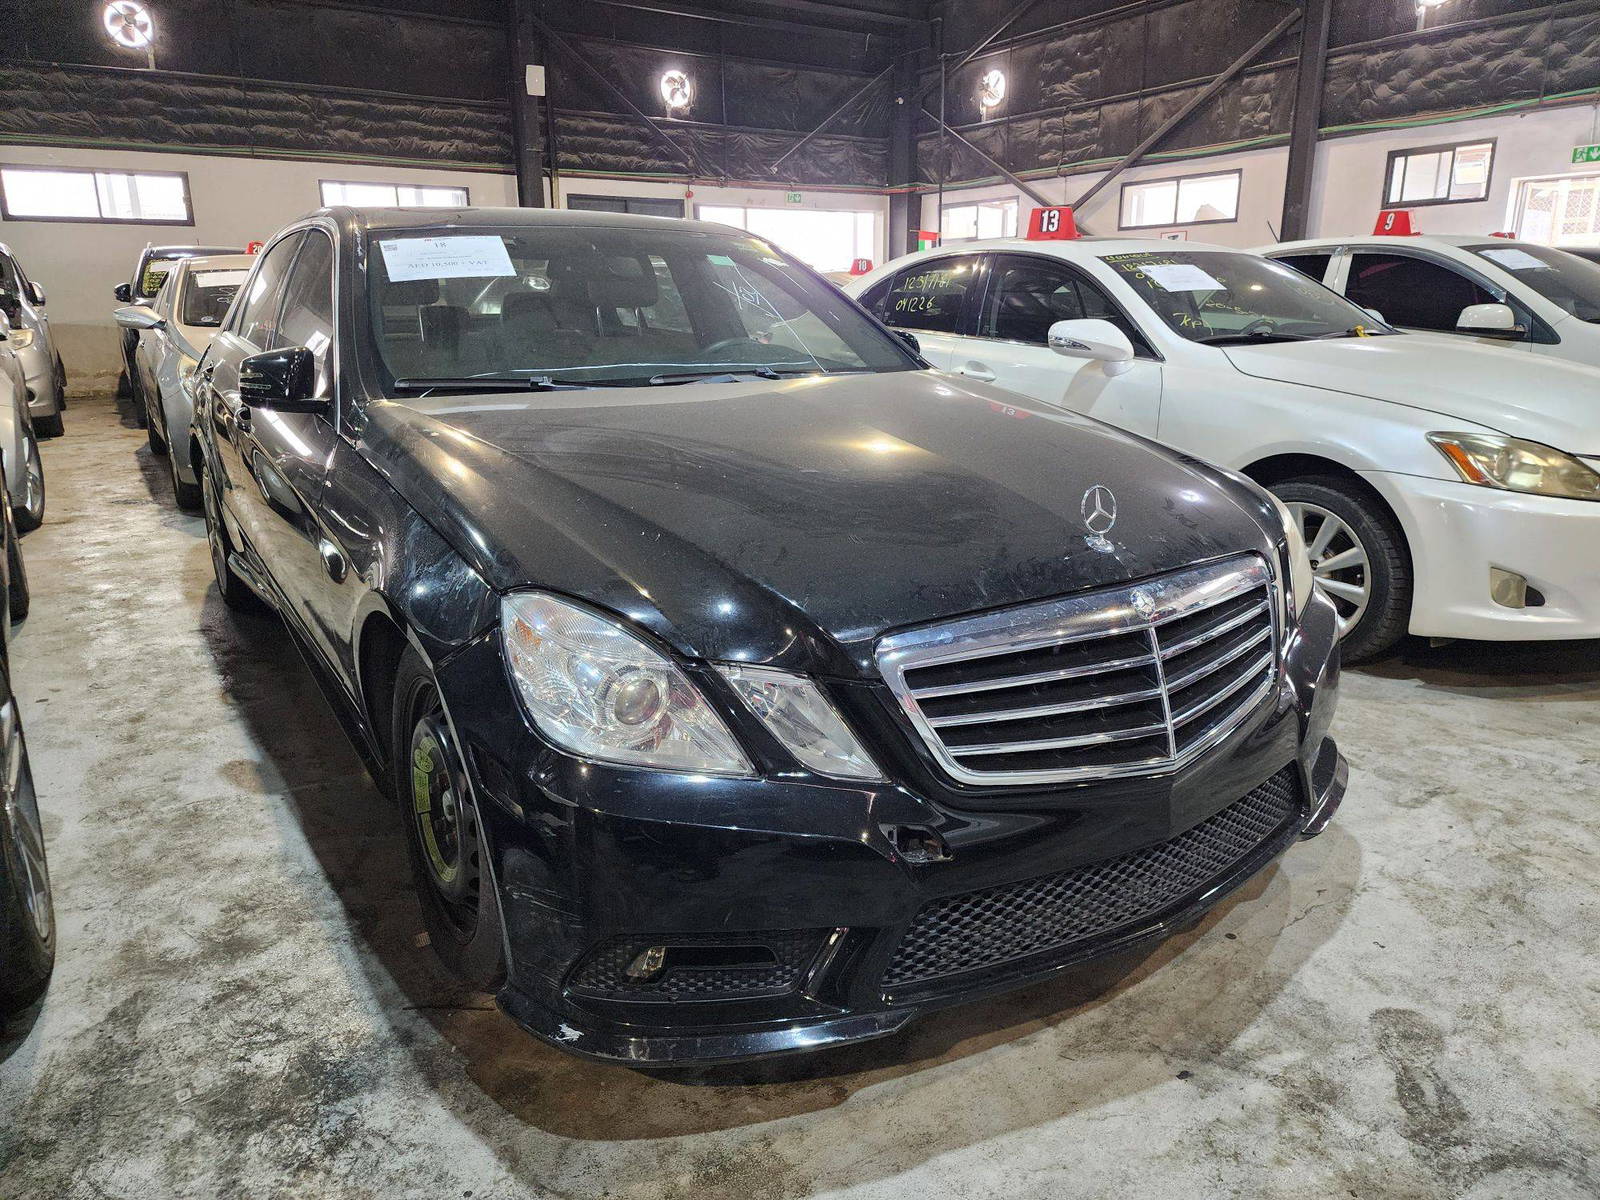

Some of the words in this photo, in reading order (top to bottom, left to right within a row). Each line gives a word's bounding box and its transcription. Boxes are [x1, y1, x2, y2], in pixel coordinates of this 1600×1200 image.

[1041, 209, 1060, 232] 13
[1384, 212, 1395, 230] 9
[858, 259, 867, 271] 10
